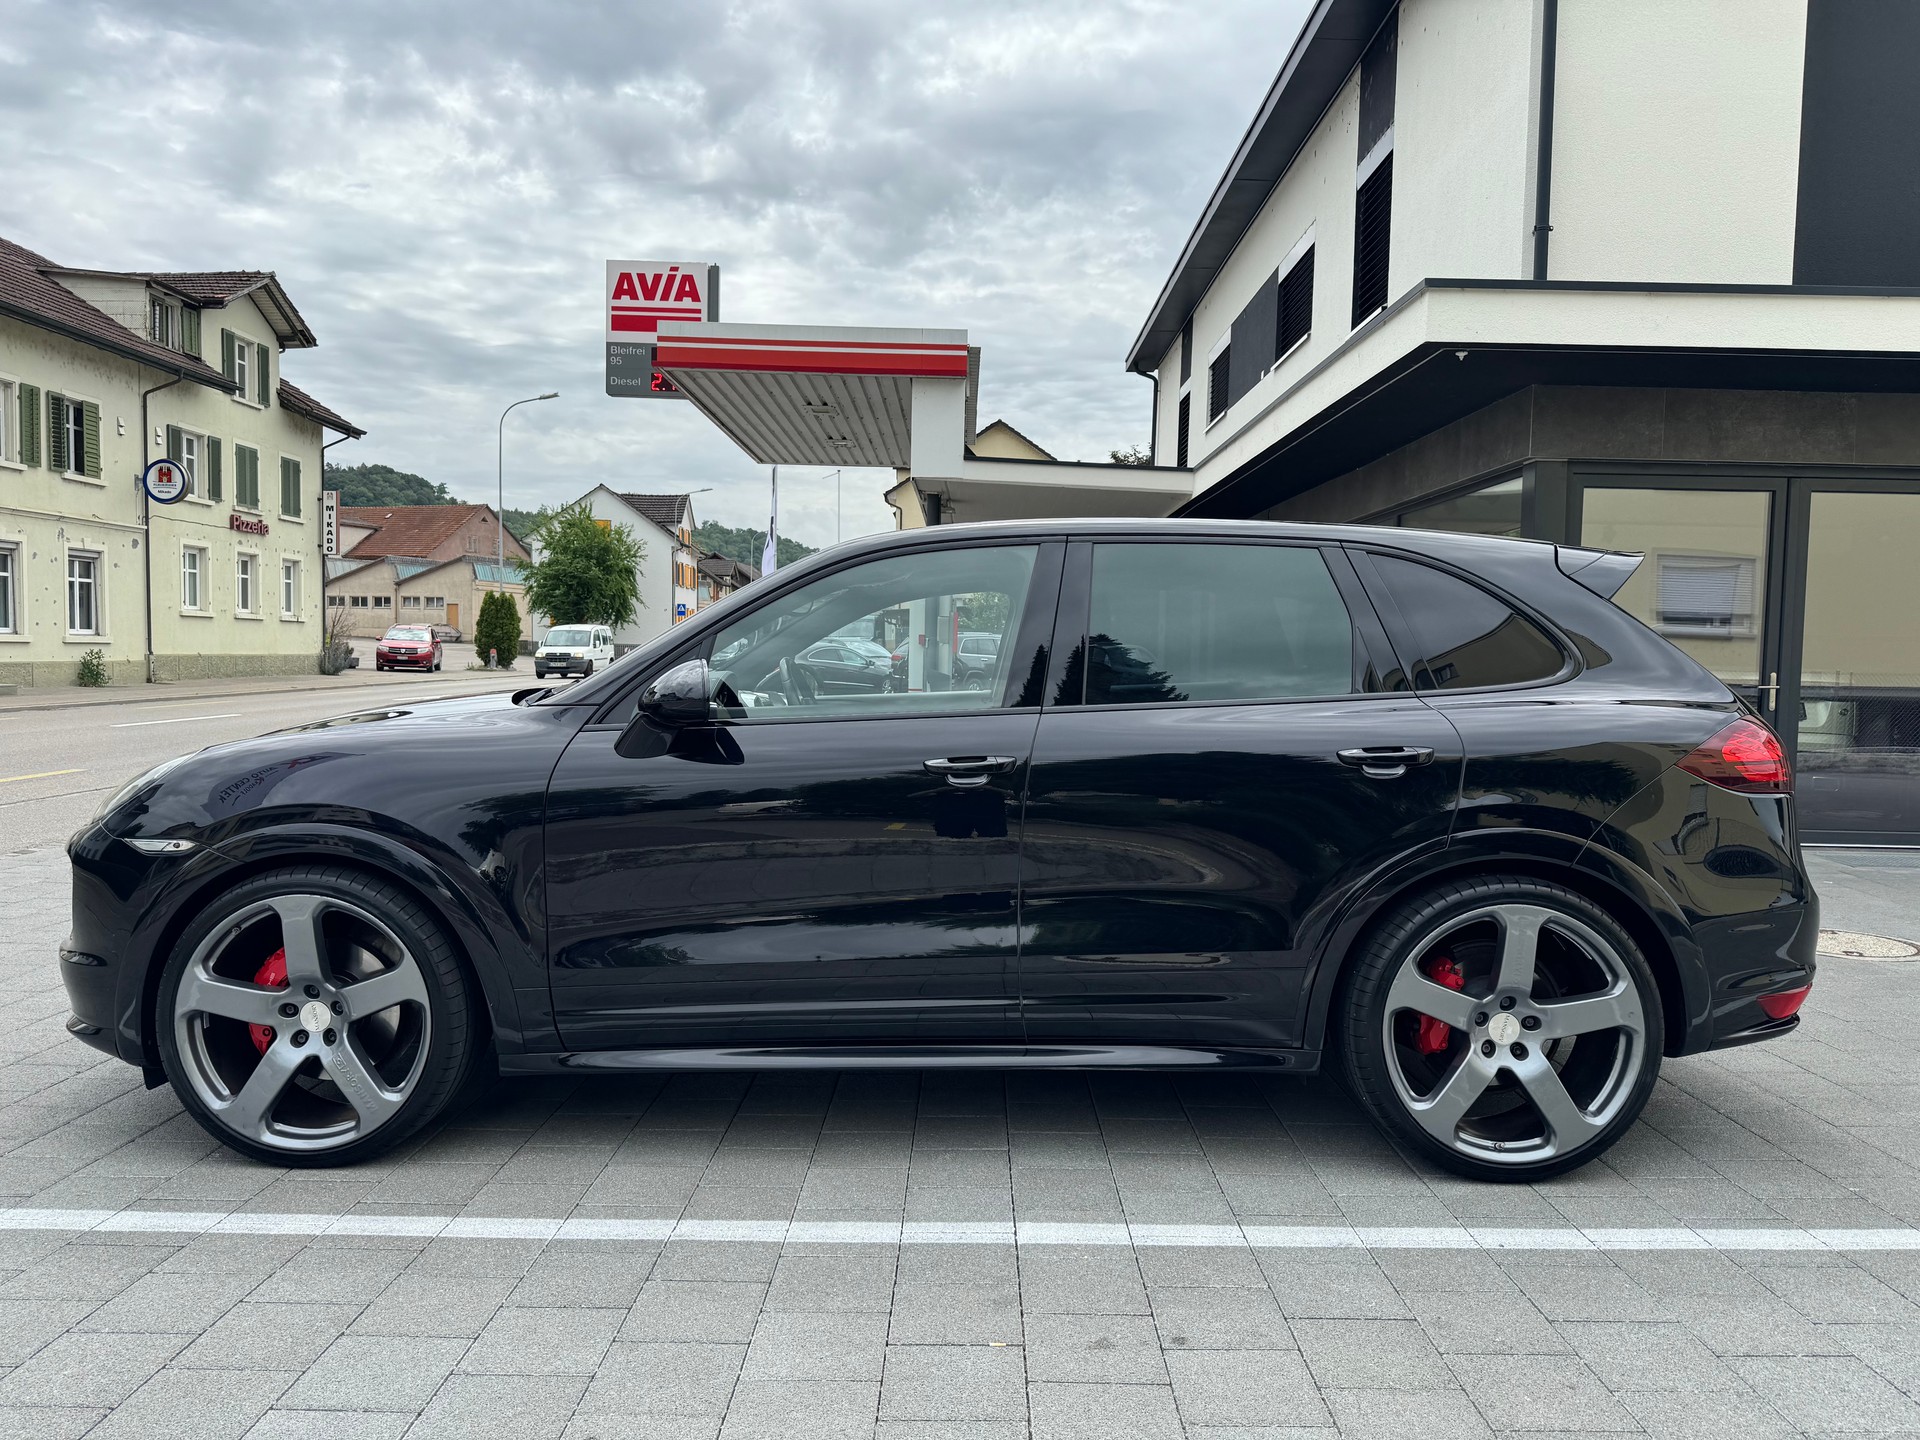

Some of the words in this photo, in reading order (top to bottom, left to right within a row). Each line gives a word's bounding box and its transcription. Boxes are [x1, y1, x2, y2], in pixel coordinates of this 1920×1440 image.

[611, 266, 702, 303] AVIA
[610, 345, 646, 355] Bleifrei
[610, 356, 622, 365] 95
[610, 376, 641, 386] Diesel
[651, 373, 677, 391] 2.
[231, 515, 269, 536] Pizzeria
[325, 505, 335, 552] MIKADO
